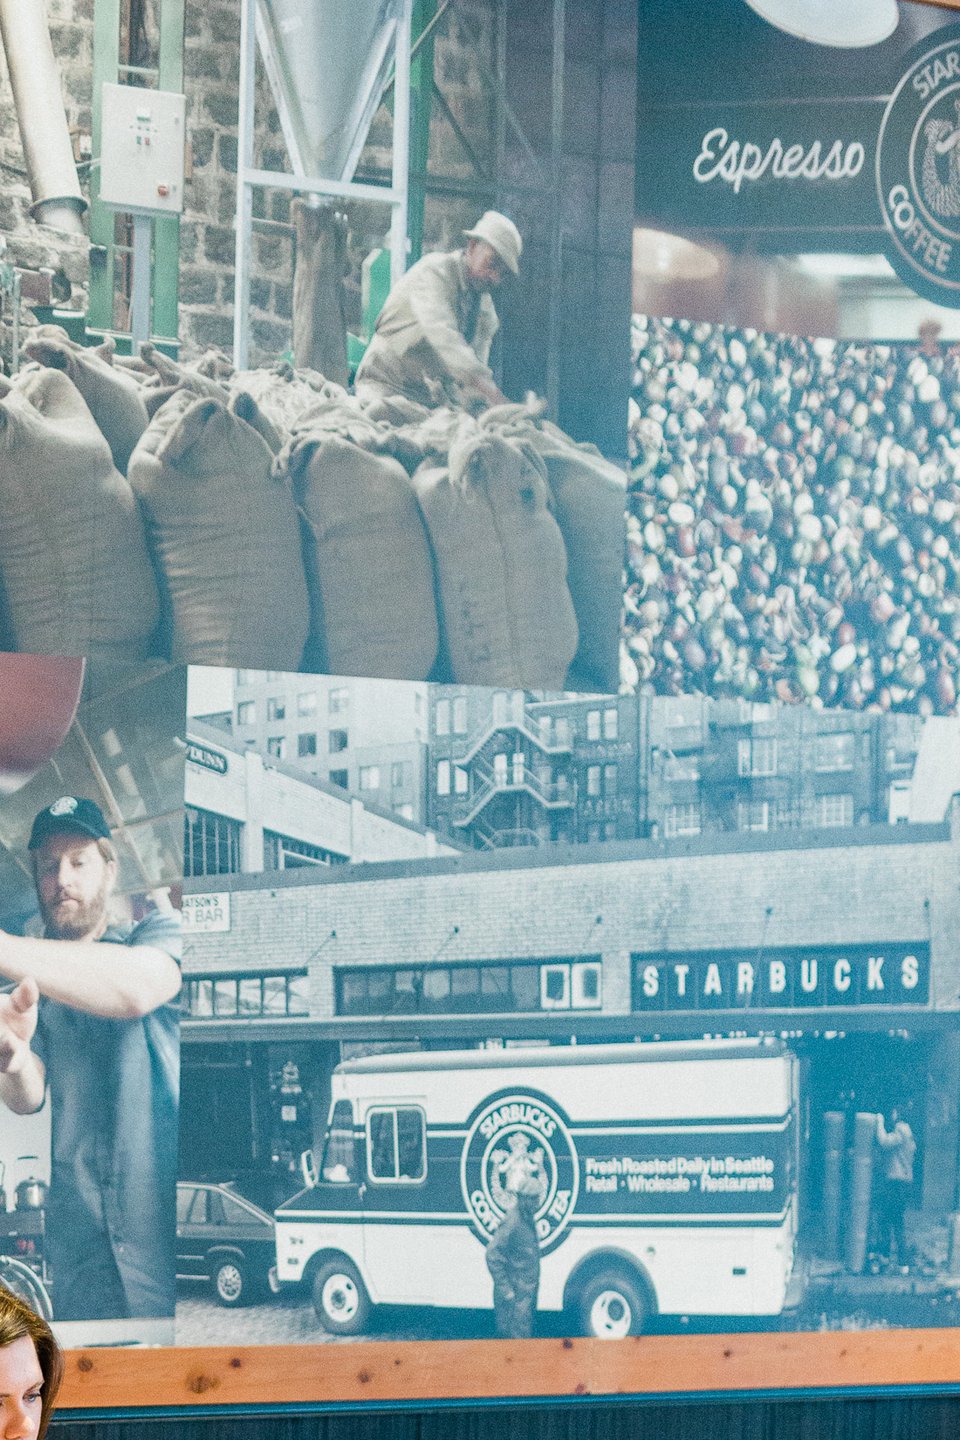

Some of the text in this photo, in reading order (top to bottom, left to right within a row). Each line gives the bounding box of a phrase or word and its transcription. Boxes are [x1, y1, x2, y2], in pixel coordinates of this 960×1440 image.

[693, 128, 865, 194] Espresso
[889, 184, 952, 272] COFFEE
[195, 908, 223, 923] BAR
[643, 955, 919, 997] STARBUCKS
[479, 1103, 557, 1139] STARBUCKS
[586, 1156, 775, 1176] Fresh Roasted Daily in Seattle
[586, 1174, 775, 1192] Retail Wholesale Restaurants
[546, 1190, 571, 1221] TEA
